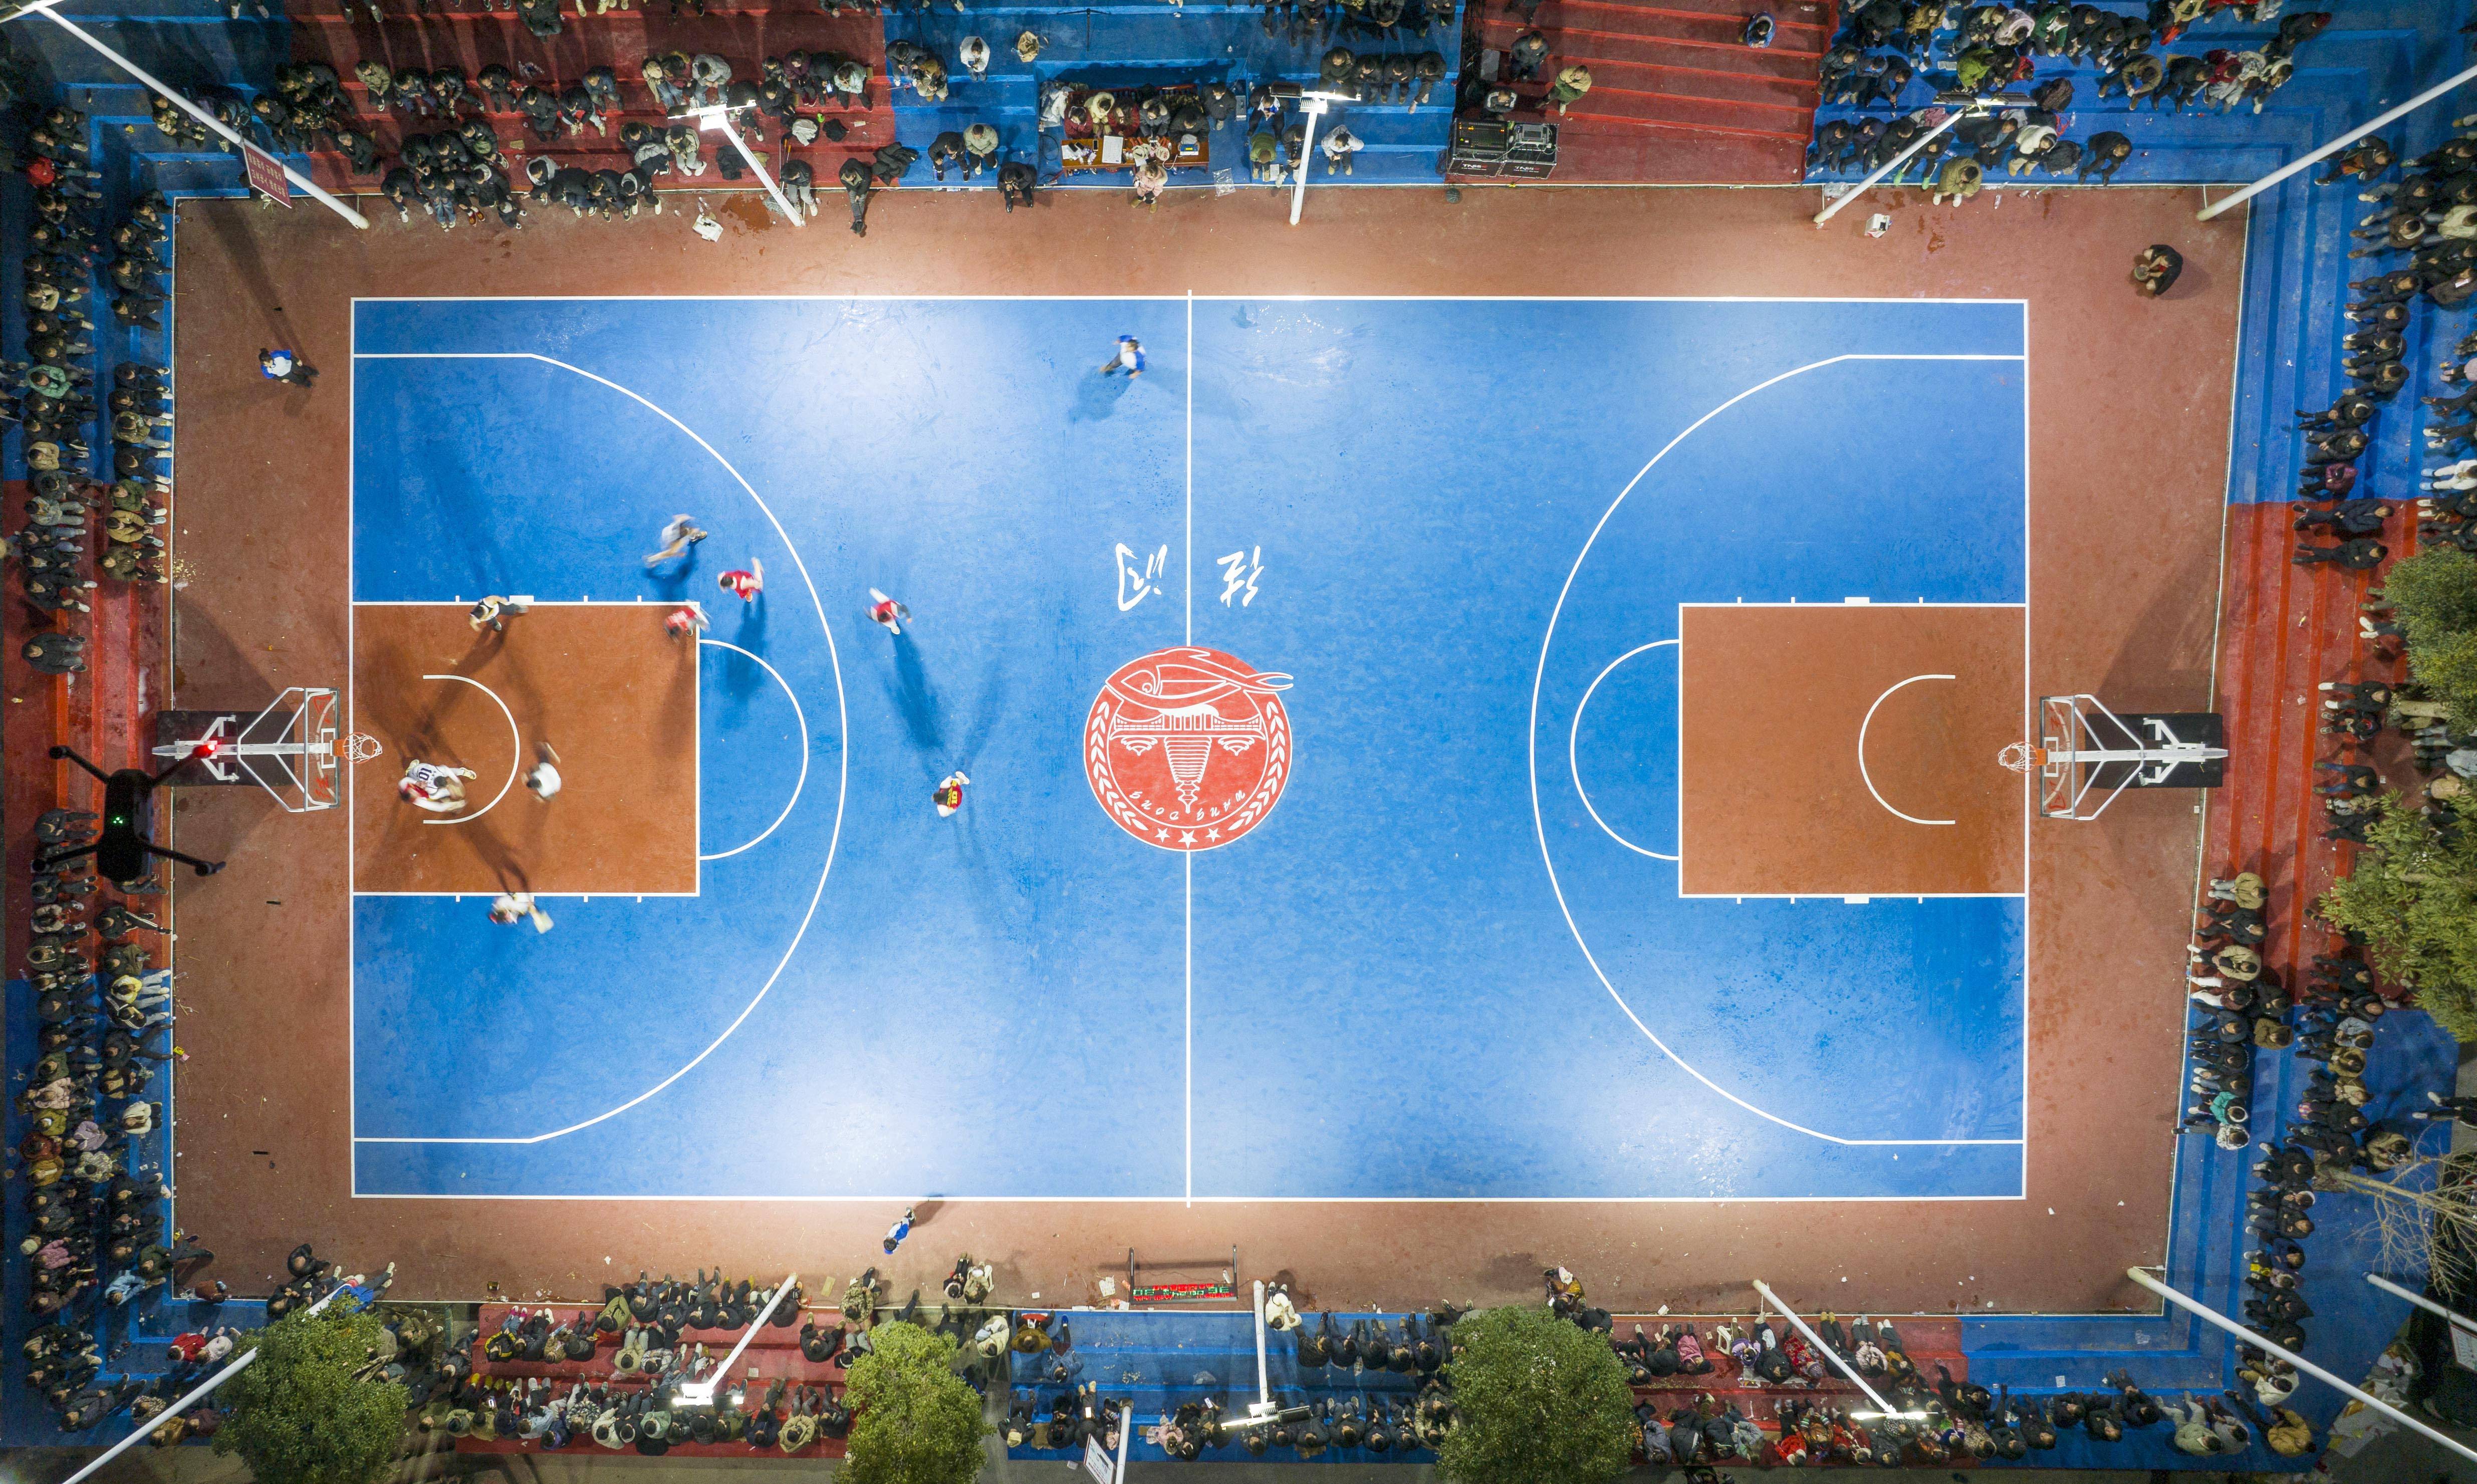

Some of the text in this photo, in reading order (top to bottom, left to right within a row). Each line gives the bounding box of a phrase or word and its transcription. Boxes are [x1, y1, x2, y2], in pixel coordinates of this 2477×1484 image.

[418, 768, 432, 781] 10
[1129, 789, 1246, 822] WANG DONG
